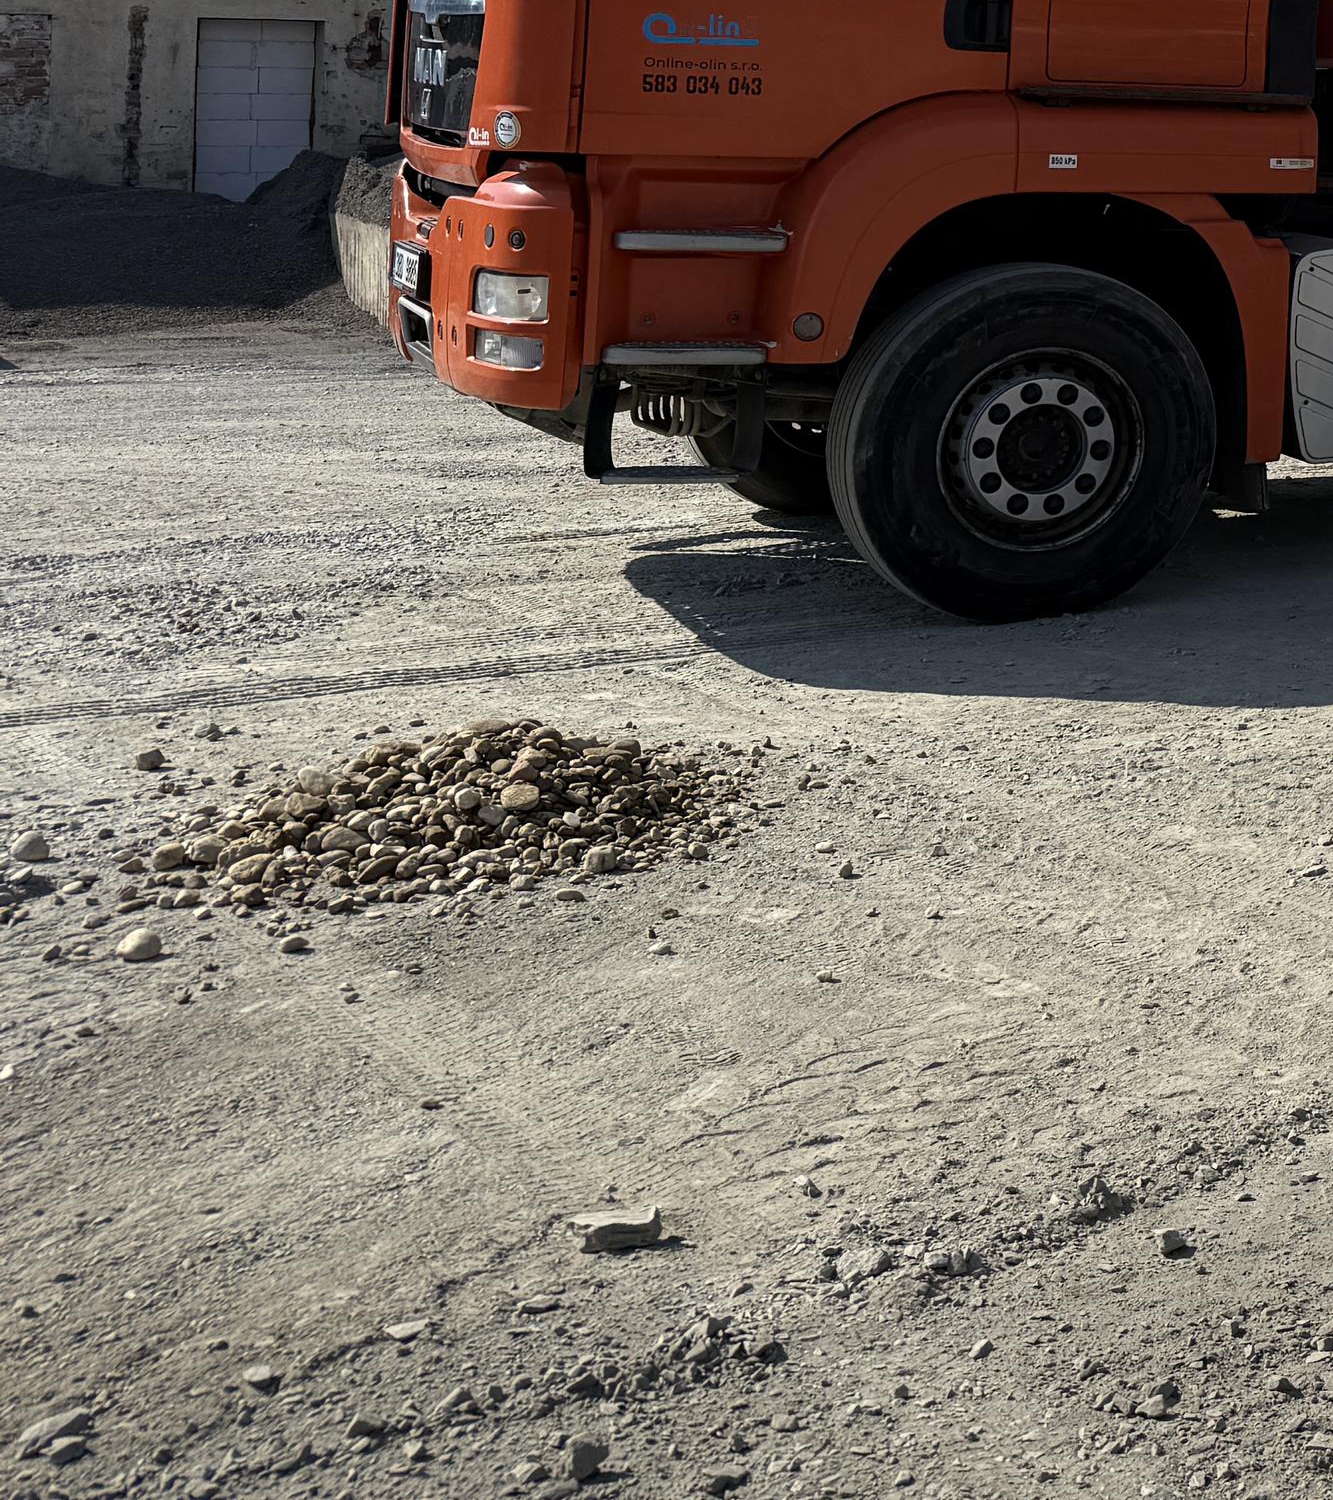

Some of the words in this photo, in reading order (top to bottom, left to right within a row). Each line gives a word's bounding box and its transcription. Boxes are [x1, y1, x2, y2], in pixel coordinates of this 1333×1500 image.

[414, 47, 448, 86] MAN
[730, 61, 762, 72] s.r.o.
[642, 74, 678, 93] 583
[686, 75, 720, 95] 034
[728, 76, 762, 96] 043
